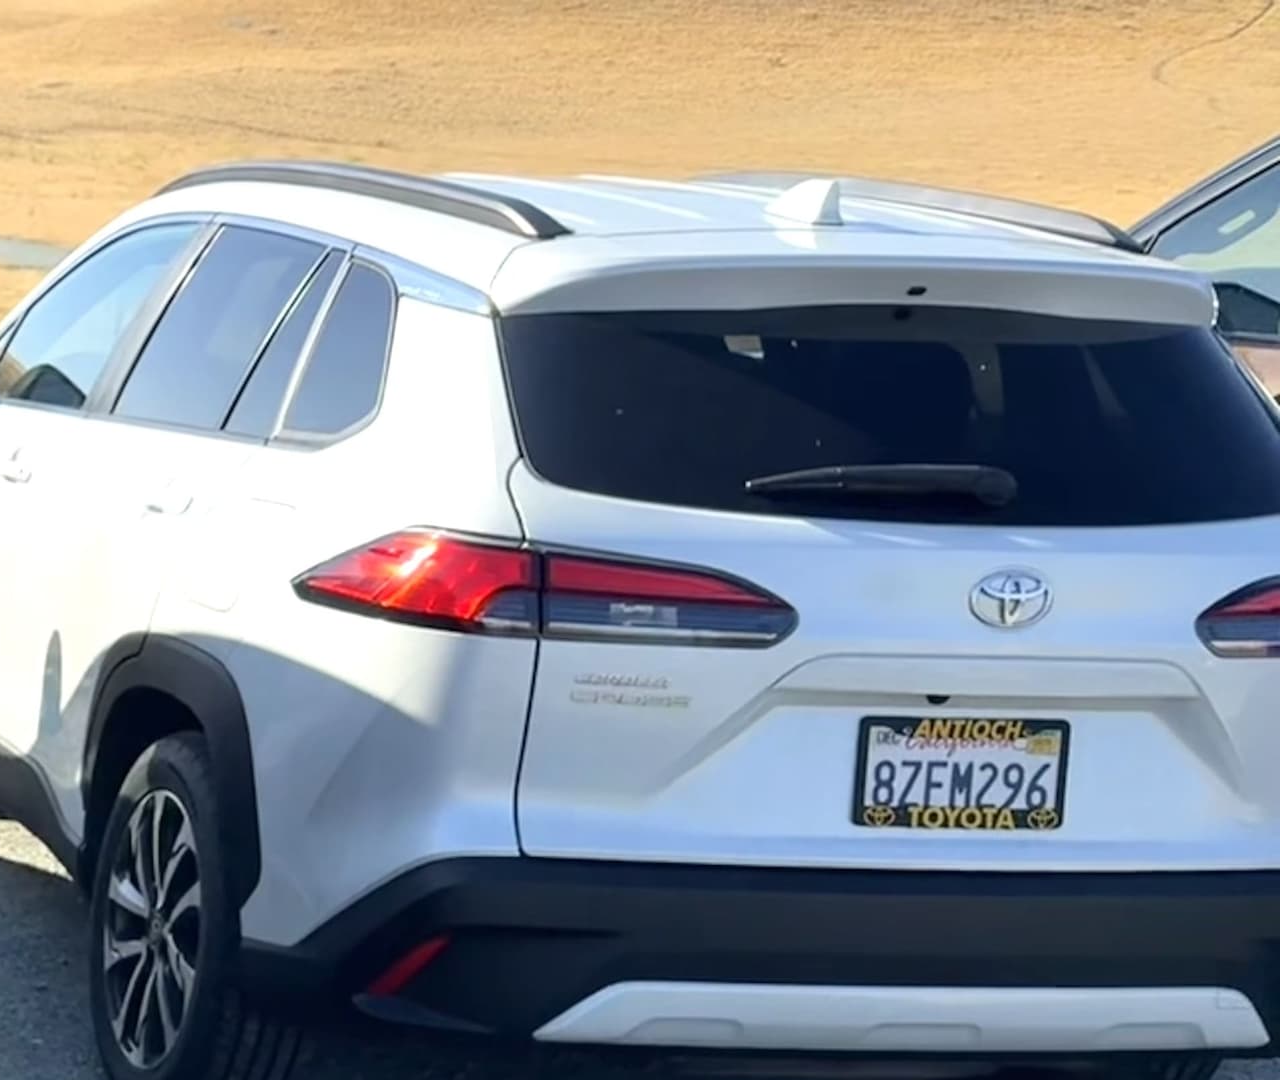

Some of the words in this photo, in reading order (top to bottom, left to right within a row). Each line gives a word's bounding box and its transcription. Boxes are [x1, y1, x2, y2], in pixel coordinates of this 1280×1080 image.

[914, 719, 1023, 741] ANTIOCH
[872, 760, 1052, 809] 8ZFM296
[907, 807, 1016, 829] TOYOTA
